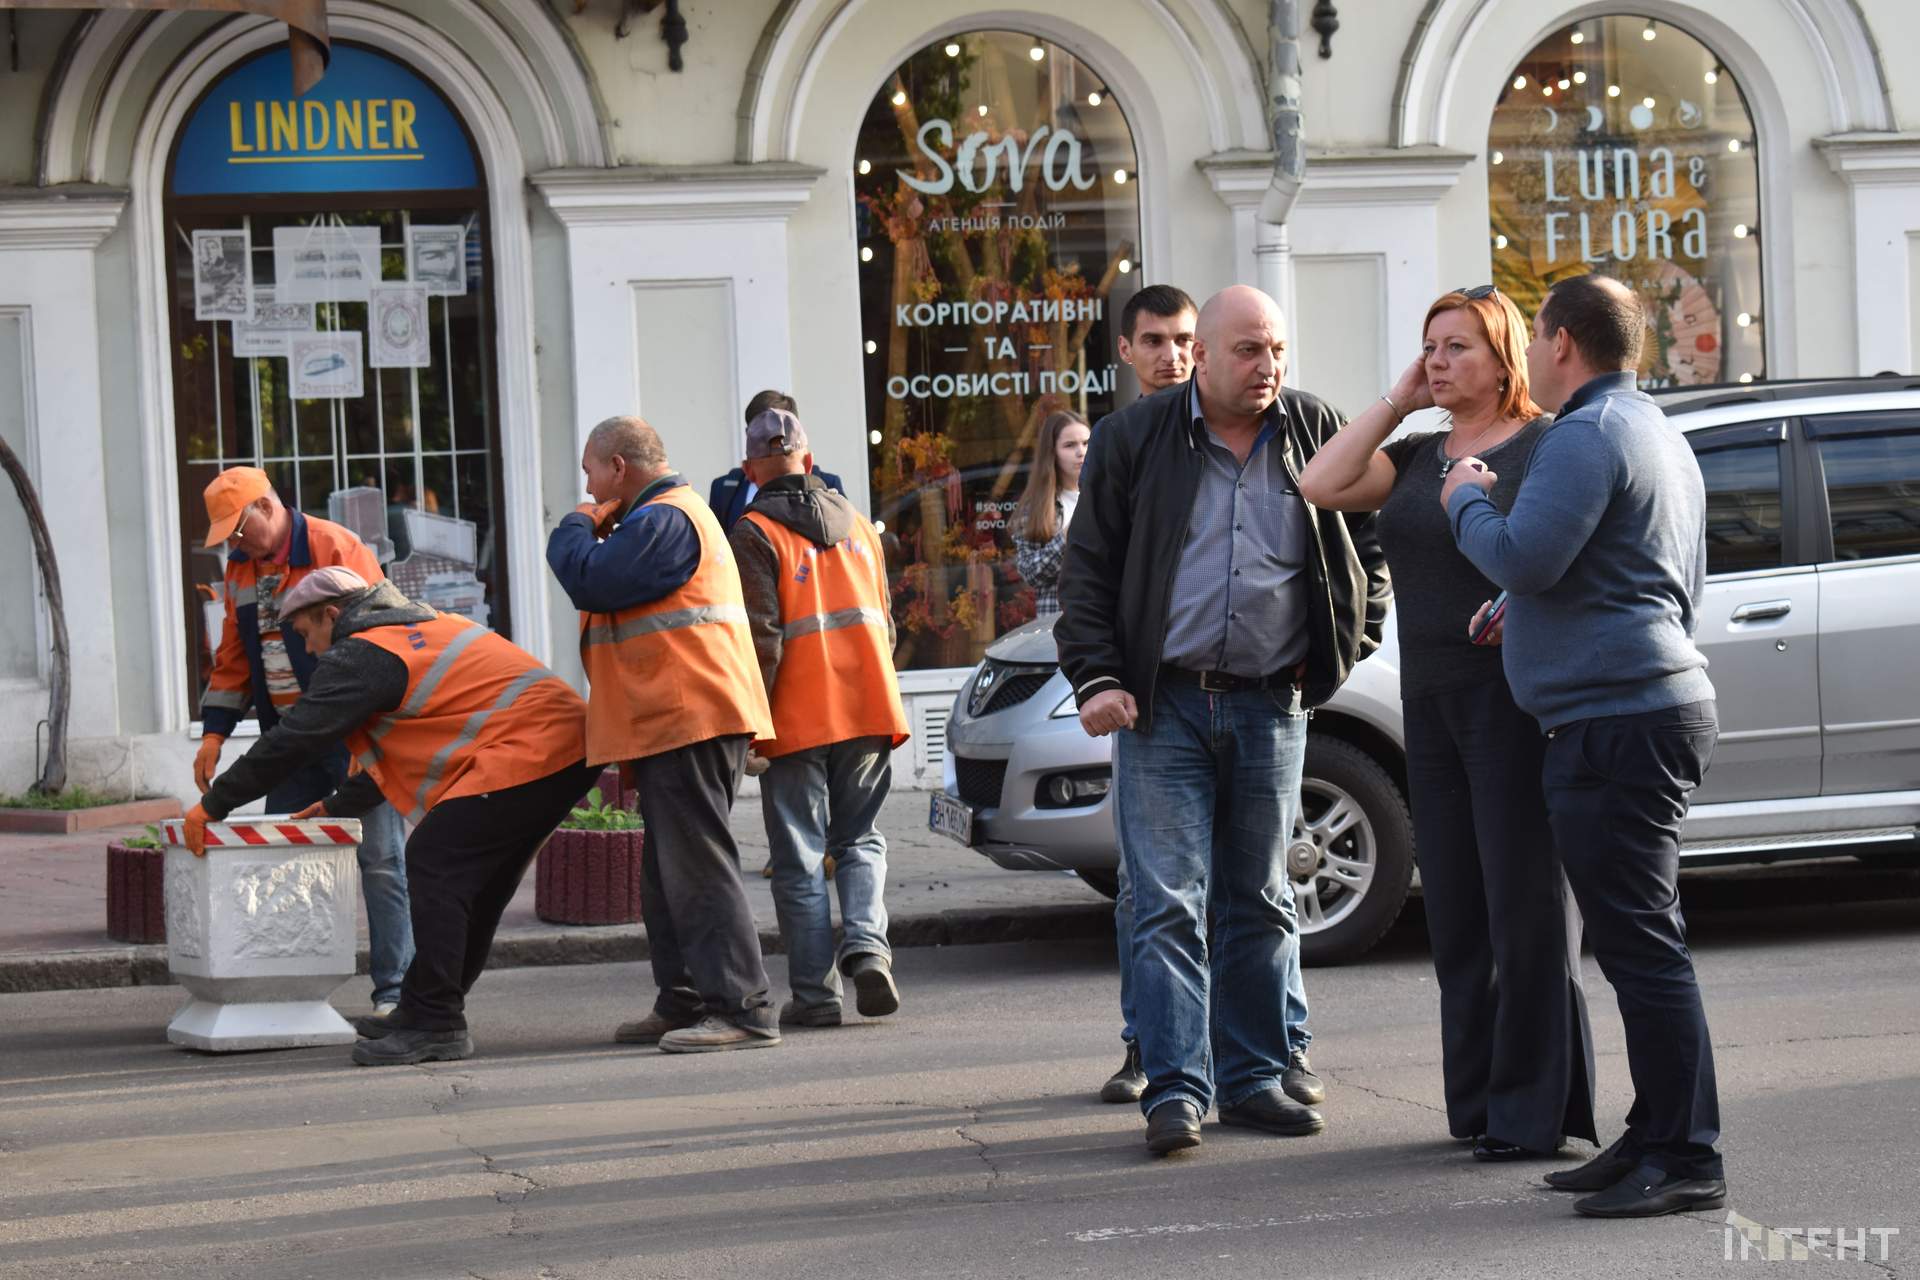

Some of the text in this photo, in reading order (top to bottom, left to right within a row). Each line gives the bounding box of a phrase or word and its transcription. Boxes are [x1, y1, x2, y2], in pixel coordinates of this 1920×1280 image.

[229, 99, 419, 152] LINDNER
[895, 118, 1096, 195] Sova
[929, 212, 1066, 231] АГЕНЦІЯ ПОДІЙ
[896, 298, 1103, 327] КОРПОРАТИВНІ
[984, 336, 1017, 361] ТА
[887, 364, 1118, 400] ОСОБИСТІ ПОДІЇ
